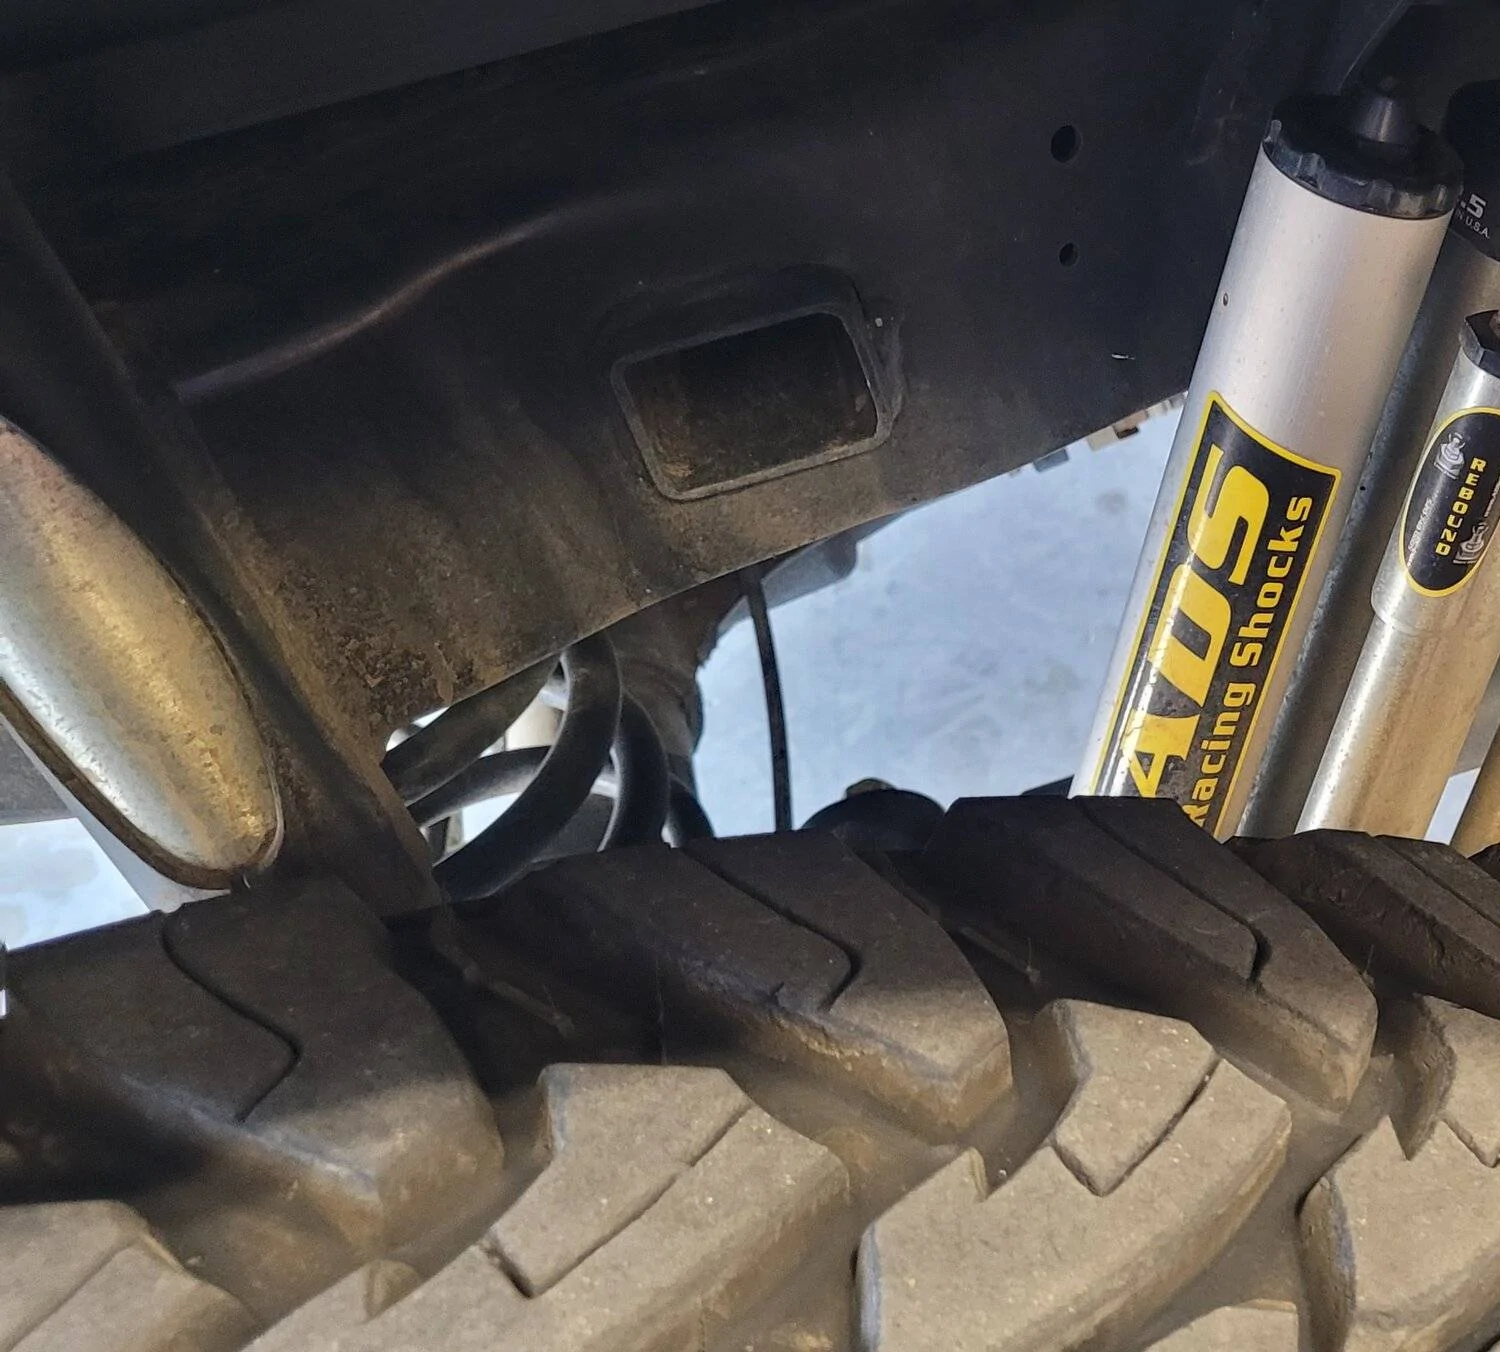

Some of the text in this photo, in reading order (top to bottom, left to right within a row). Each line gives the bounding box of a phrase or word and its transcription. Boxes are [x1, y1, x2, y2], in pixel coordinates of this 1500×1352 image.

[1229, 496, 1313, 667] Shocks
[1435, 457, 1487, 556] REBOUND
[1120, 443, 1270, 798] ADS
